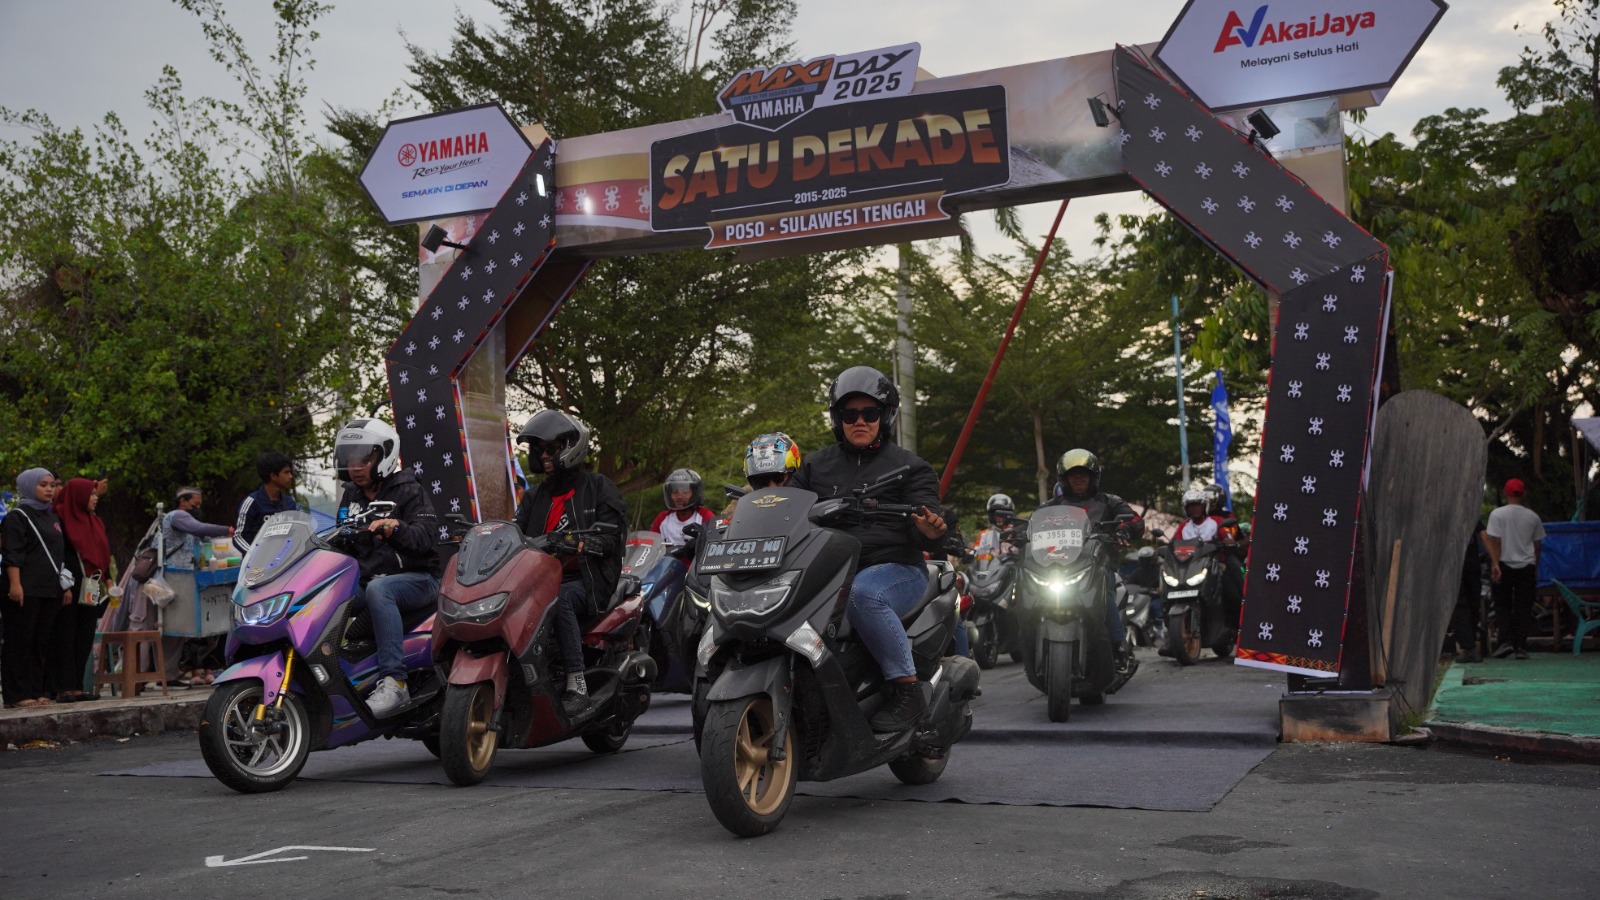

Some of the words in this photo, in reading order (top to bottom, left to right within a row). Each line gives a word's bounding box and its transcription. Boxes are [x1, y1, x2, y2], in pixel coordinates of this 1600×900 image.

[1259, 11, 1376, 45] AkaiJaya
[1240, 52, 1291, 68] Melayani
[1293, 46, 1333, 60] Setulus
[1336, 41, 1359, 54] Hati
[720, 57, 834, 99] MAXI
[833, 48, 914, 80] DAY
[833, 71, 902, 100] 2025
[742, 96, 804, 120] YAMAHA
[418, 132, 489, 163] YAMAHA
[658, 139, 780, 211] SATU
[792, 108, 1001, 182] DEKADE
[412, 166, 439, 180] Revs
[438, 162, 459, 175] Your
[458, 157, 482, 168] Heart
[455, 179, 488, 191] DEPAN
[794, 186, 848, 205] 2015-2025
[725, 220, 765, 241] POSO
[779, 209, 858, 236] SULAWESI
[862, 199, 926, 223] TENGAH
[708, 544, 726, 557] DN
